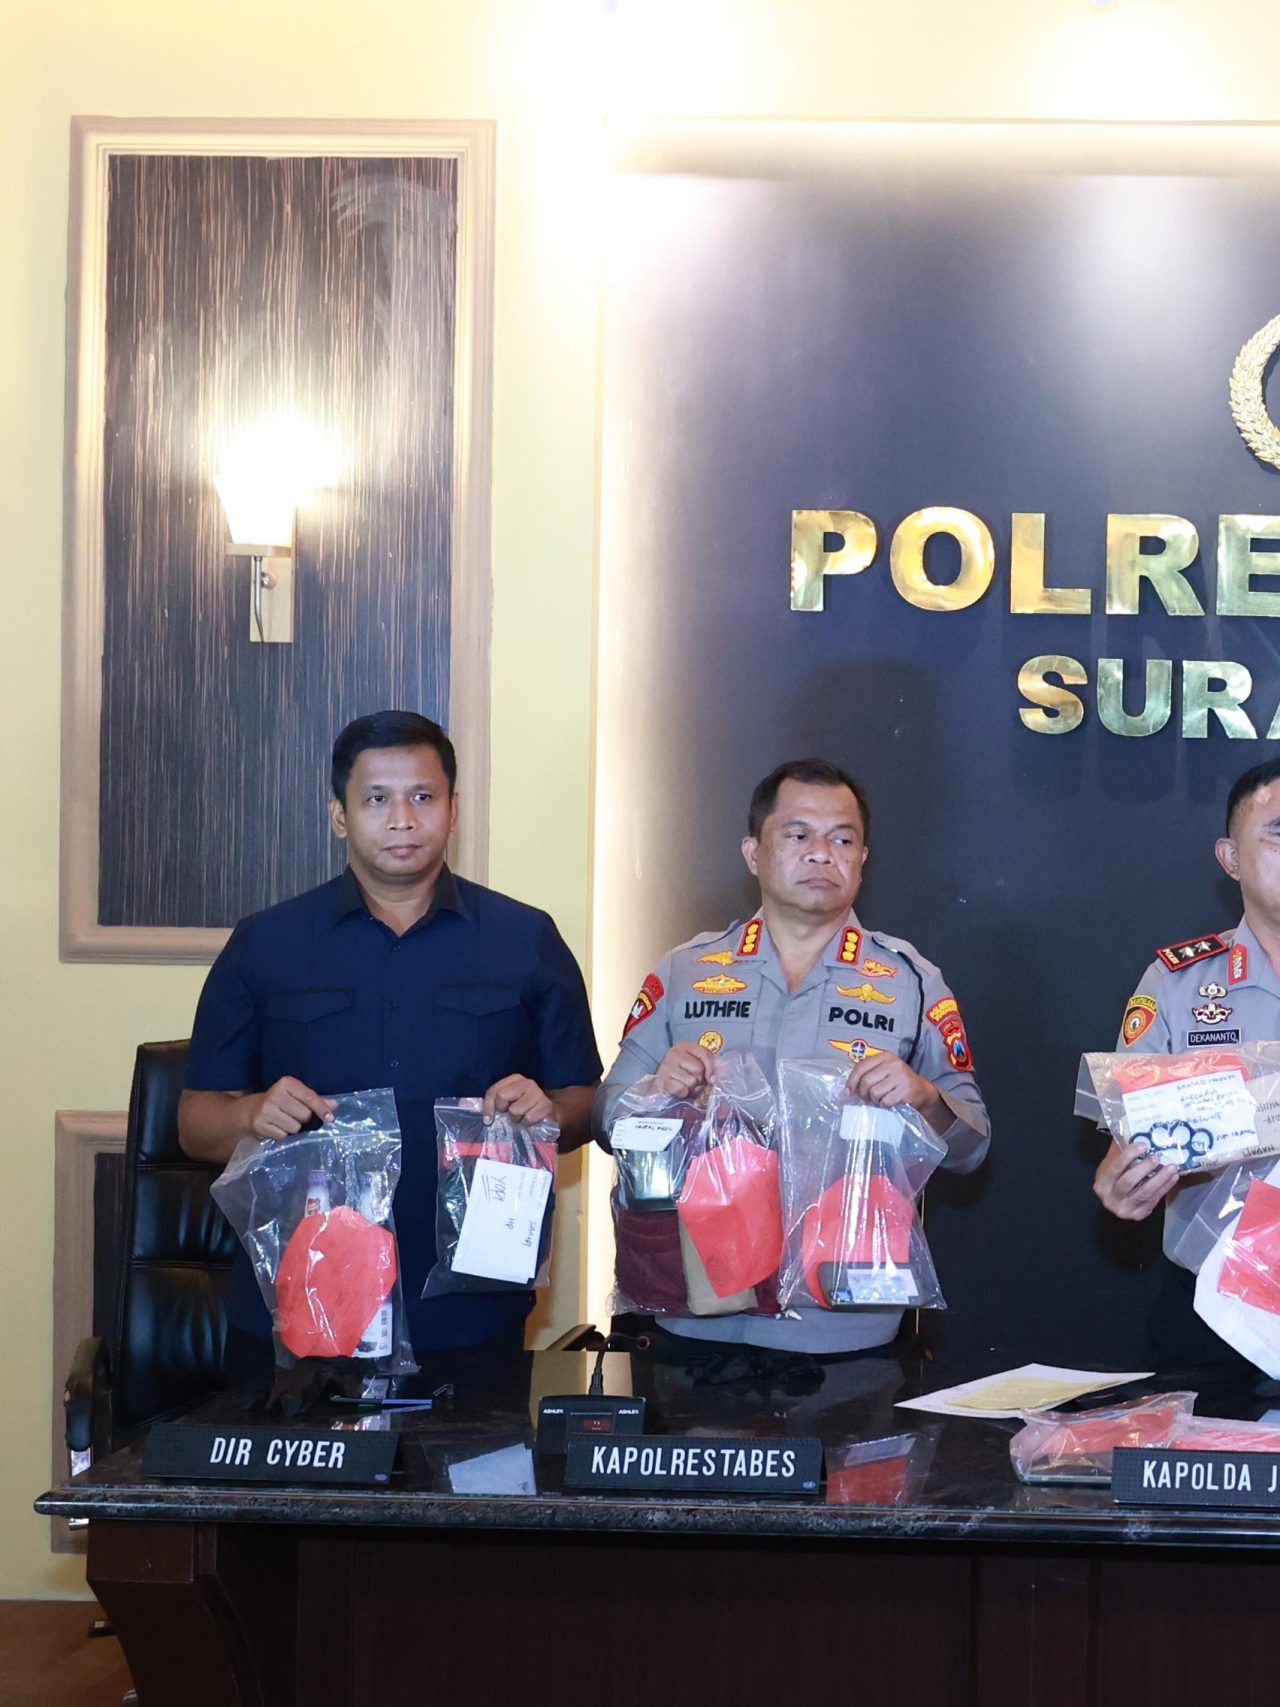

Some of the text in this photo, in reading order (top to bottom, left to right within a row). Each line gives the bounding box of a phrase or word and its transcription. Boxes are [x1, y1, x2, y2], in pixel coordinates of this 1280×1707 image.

[685, 1001, 751, 1019] LUTHFIE
[829, 1006, 895, 1033] POLRI
[210, 1437, 345, 1469] DIR CYBER
[591, 1446, 795, 1477] KAPOLRESTABES
[1143, 1460, 1251, 1491] KAPOLDA
